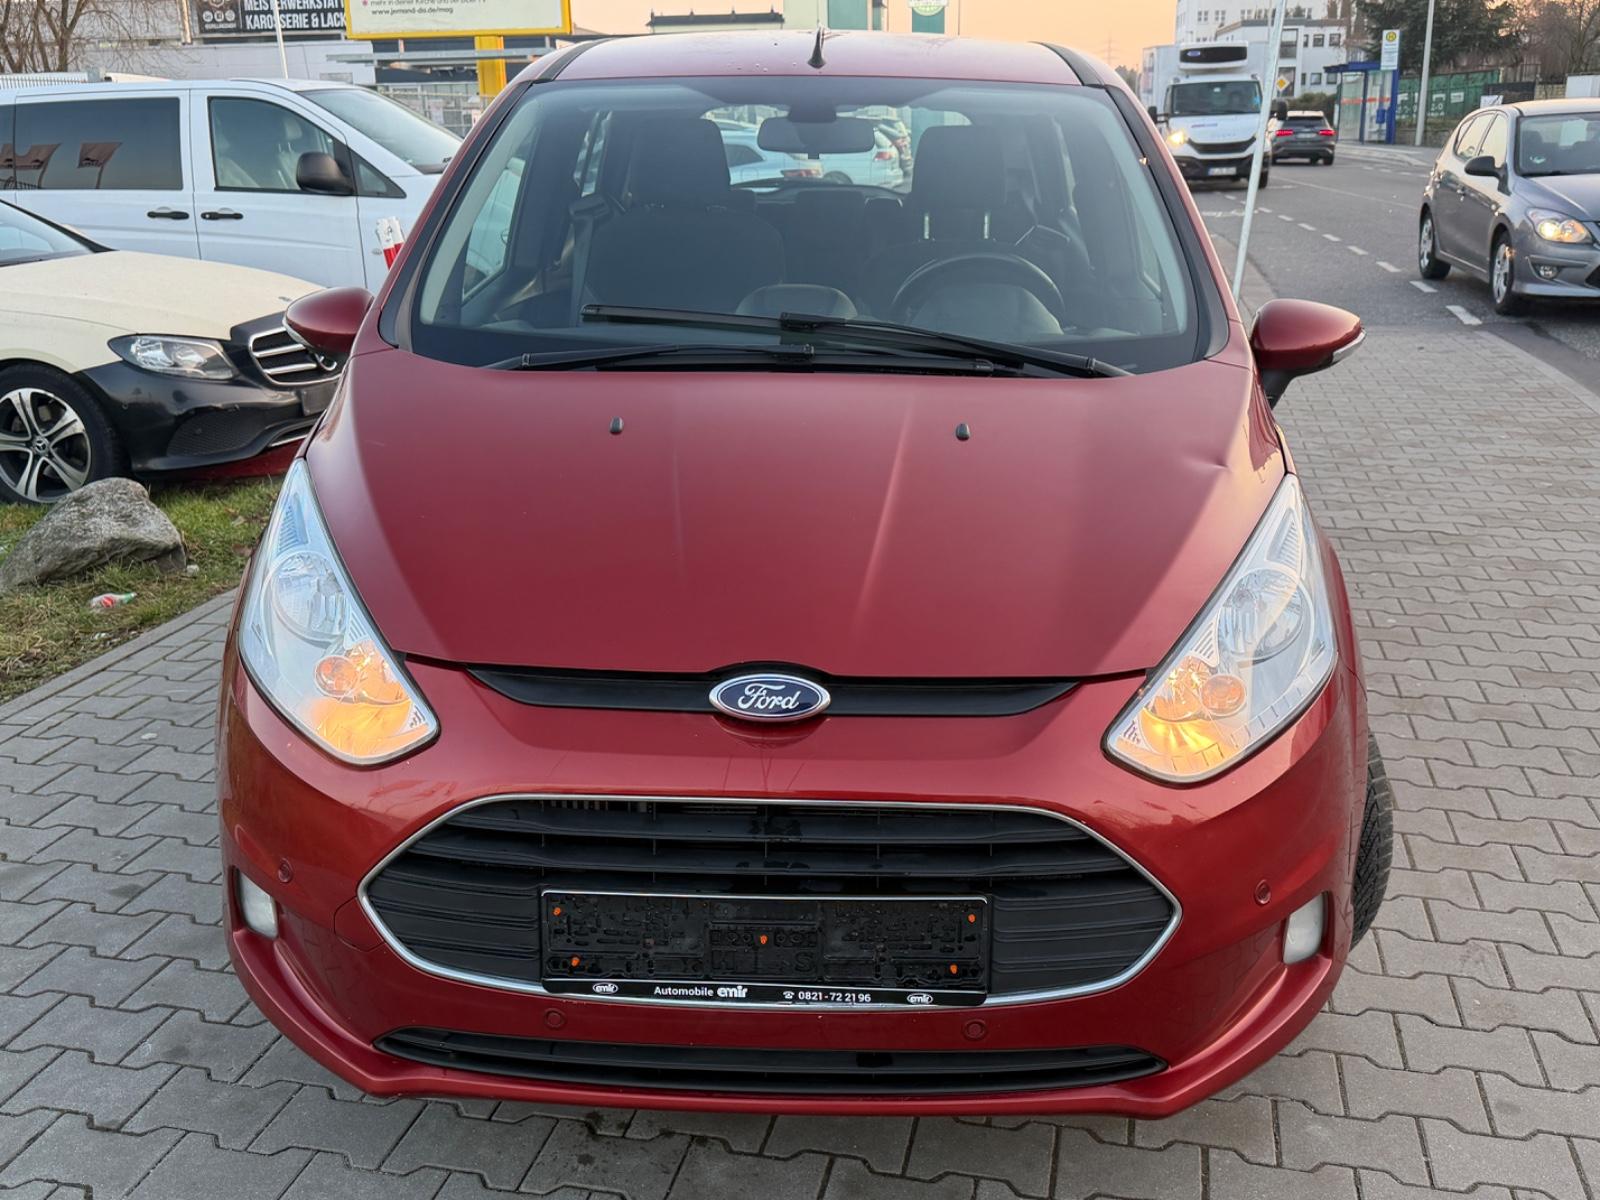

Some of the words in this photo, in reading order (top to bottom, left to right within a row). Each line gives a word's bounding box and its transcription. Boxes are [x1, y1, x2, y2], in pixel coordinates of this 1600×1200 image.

[311, 12, 319, 28] &
[737, 683, 801, 709] Ford
[594, 983, 616, 993] emir
[653, 987, 714, 997] Automobile
[716, 985, 748, 998] emir
